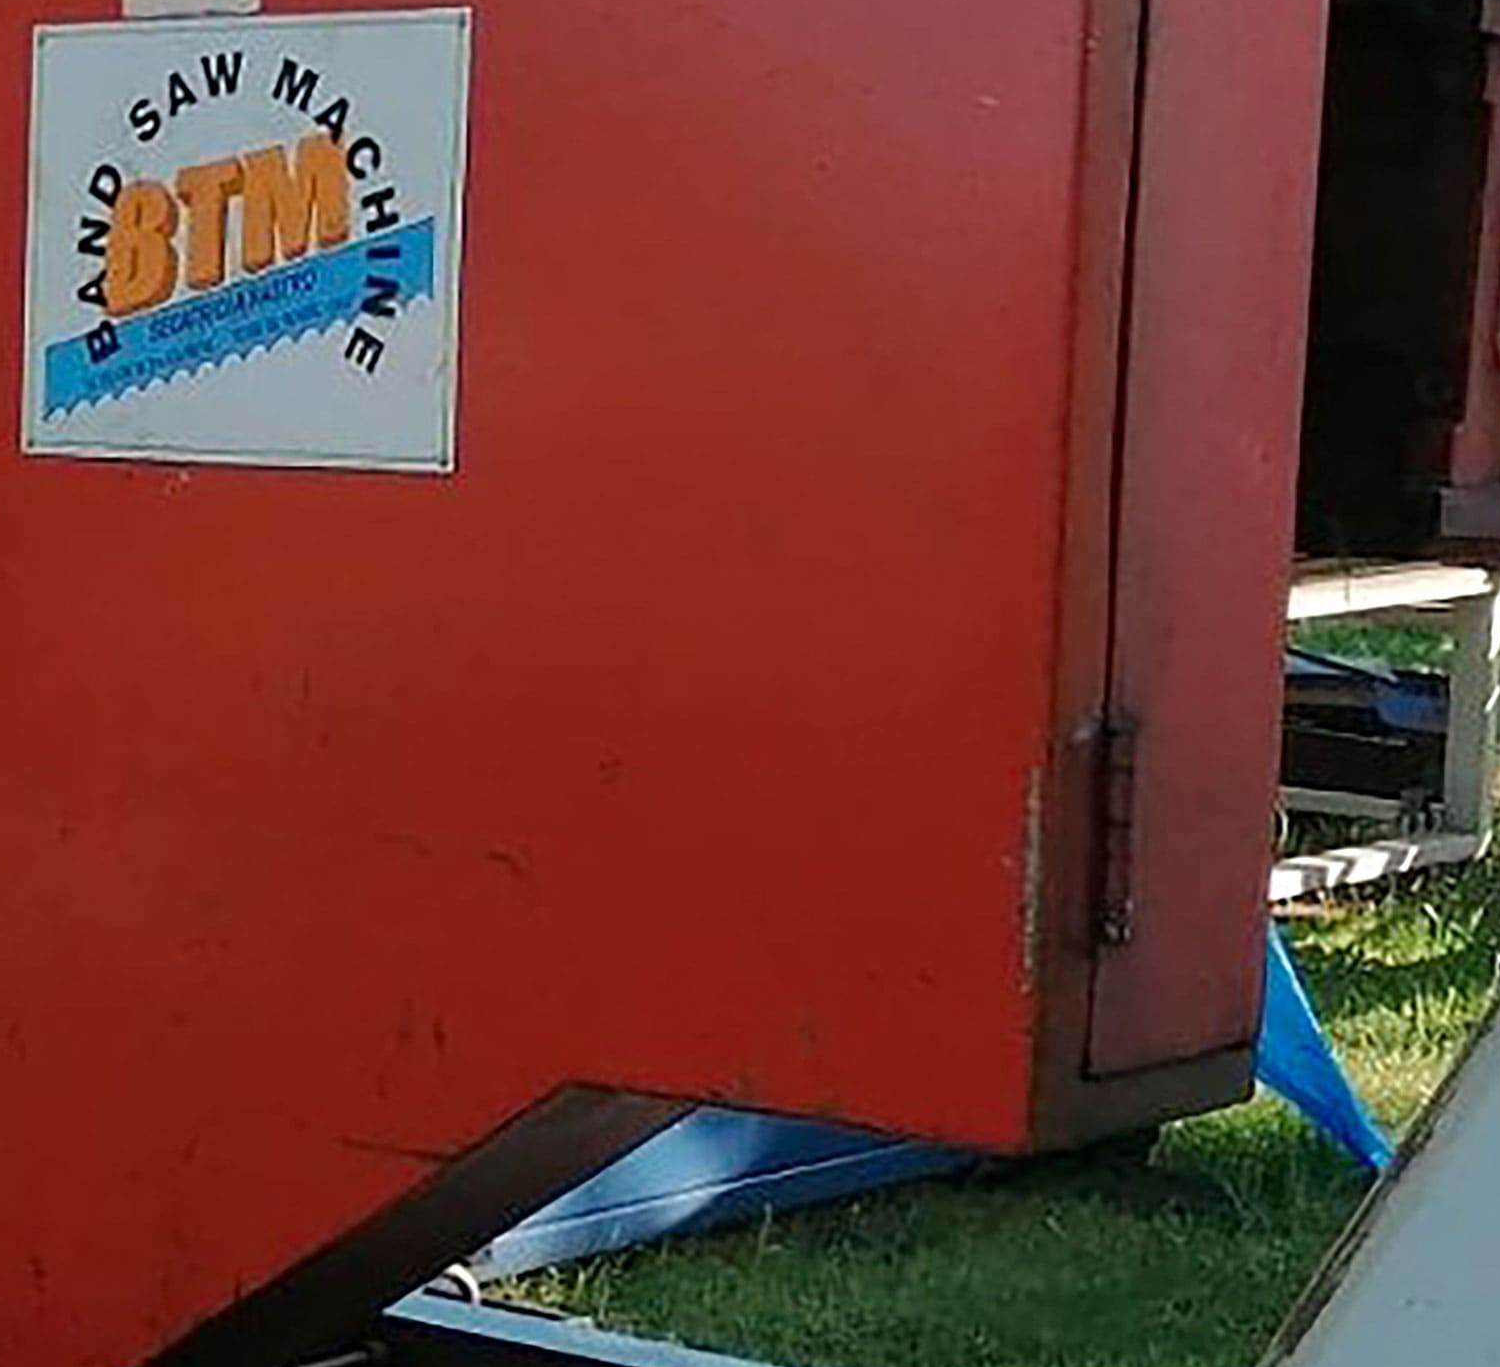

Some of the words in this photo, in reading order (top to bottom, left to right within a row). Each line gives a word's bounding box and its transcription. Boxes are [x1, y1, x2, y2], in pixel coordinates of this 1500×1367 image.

[77, 164, 122, 363] BAND
[128, 52, 243, 141] SAW
[273, 58, 401, 374] MACHINE
[103, 134, 351, 318] BTM
